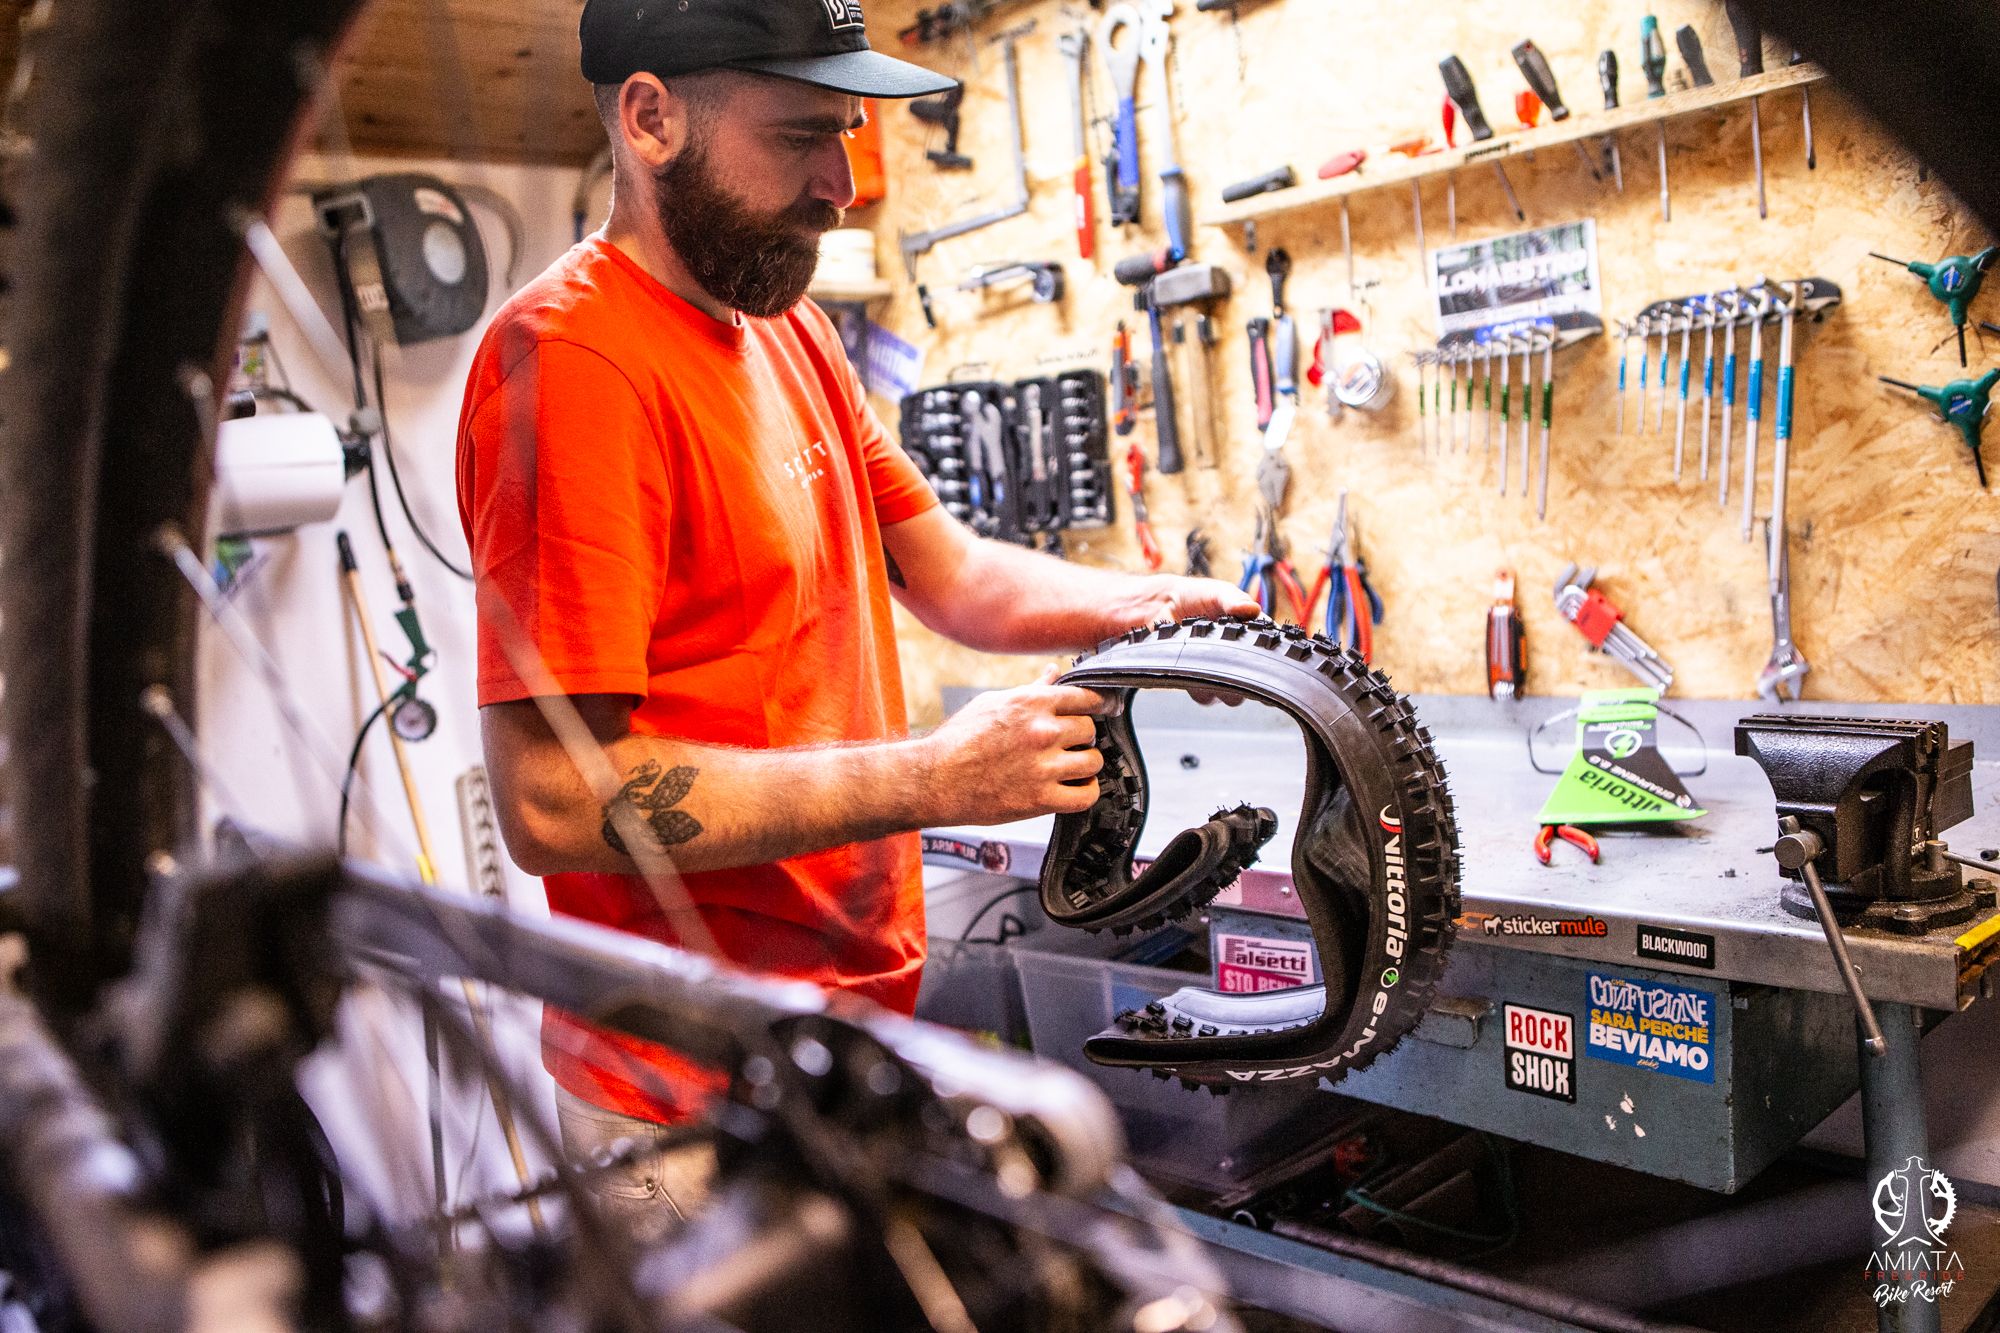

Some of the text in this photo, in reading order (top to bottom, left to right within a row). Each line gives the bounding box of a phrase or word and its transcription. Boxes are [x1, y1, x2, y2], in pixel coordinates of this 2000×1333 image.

[1579, 769, 1663, 813] vittoria
[1503, 916, 1606, 935] stickermule
[1642, 933, 1708, 960] BLACKWOOD
[1225, 938, 1307, 972] Falsetti
[1590, 975, 1709, 1027] CONFUSIONE
[1510, 1010, 1568, 1053] ROCK
[1589, 1021, 1709, 1071] BEVIAMO
[1511, 1051, 1569, 1095] SHOX
